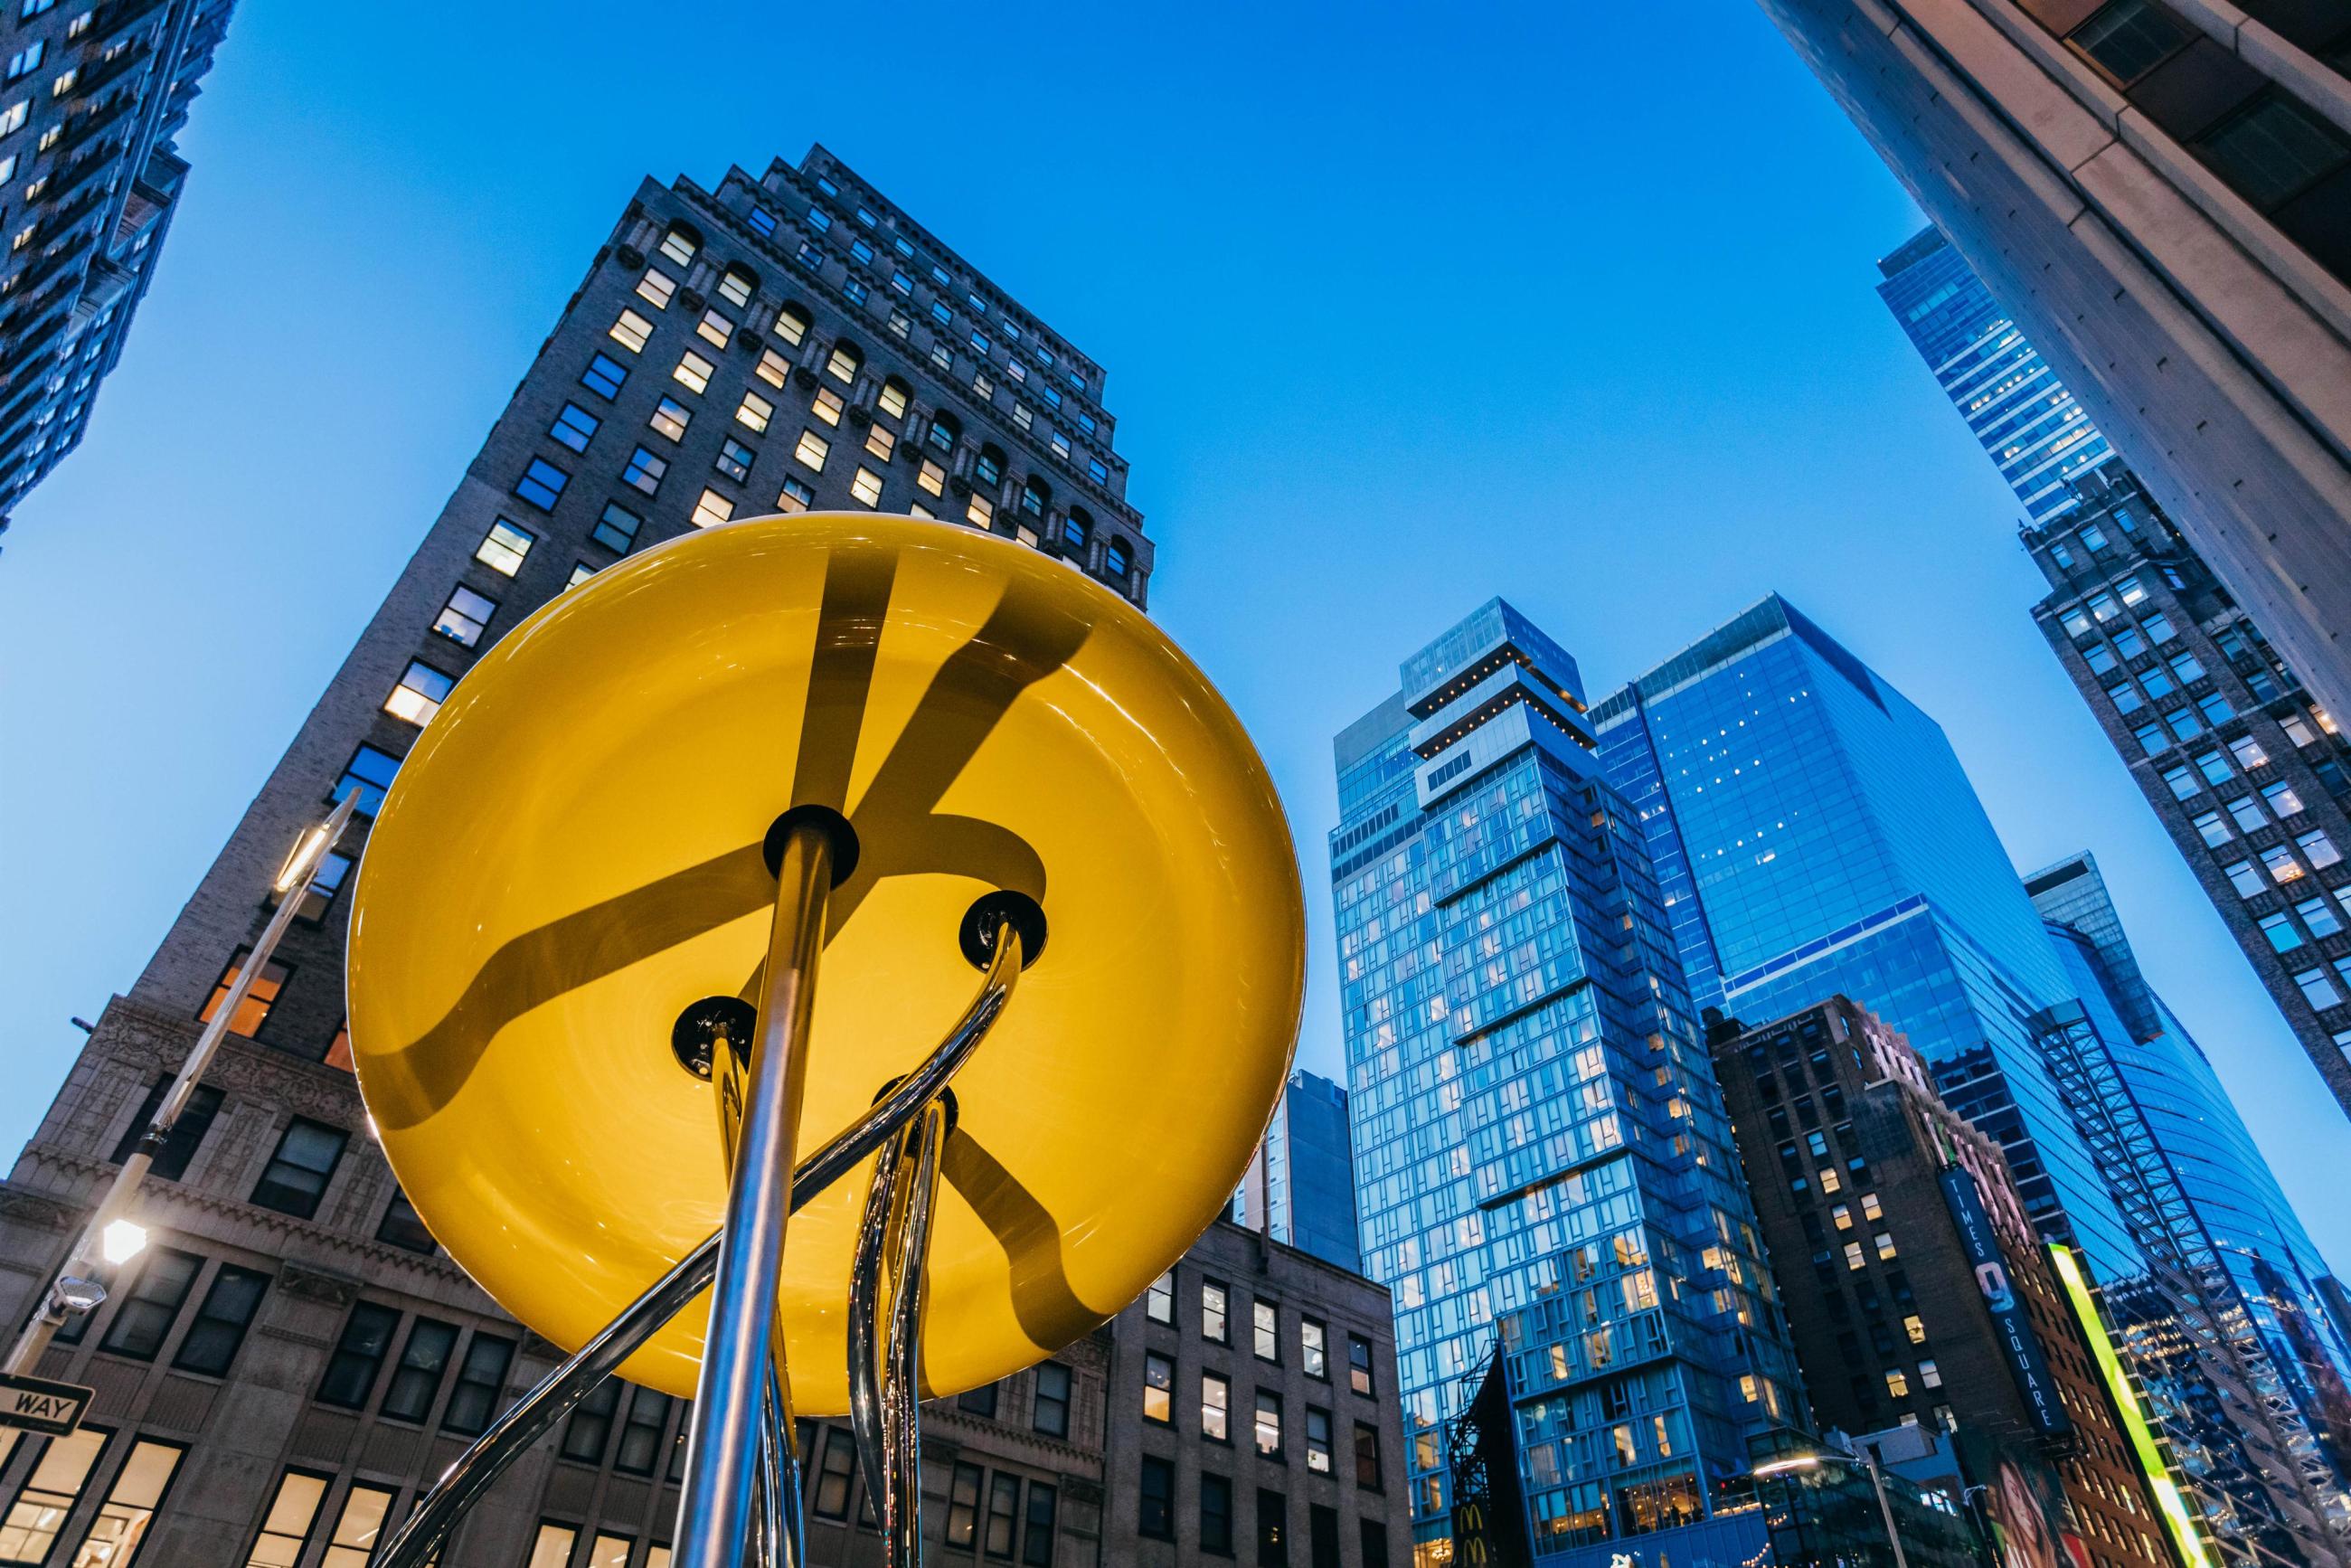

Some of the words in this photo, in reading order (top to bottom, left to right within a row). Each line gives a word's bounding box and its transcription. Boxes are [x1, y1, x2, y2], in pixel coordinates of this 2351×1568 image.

[1950, 1179, 1985, 1257] TIMES
[2005, 1318, 2052, 1426] SQUARE
[15, 1393, 72, 1418] WAY
